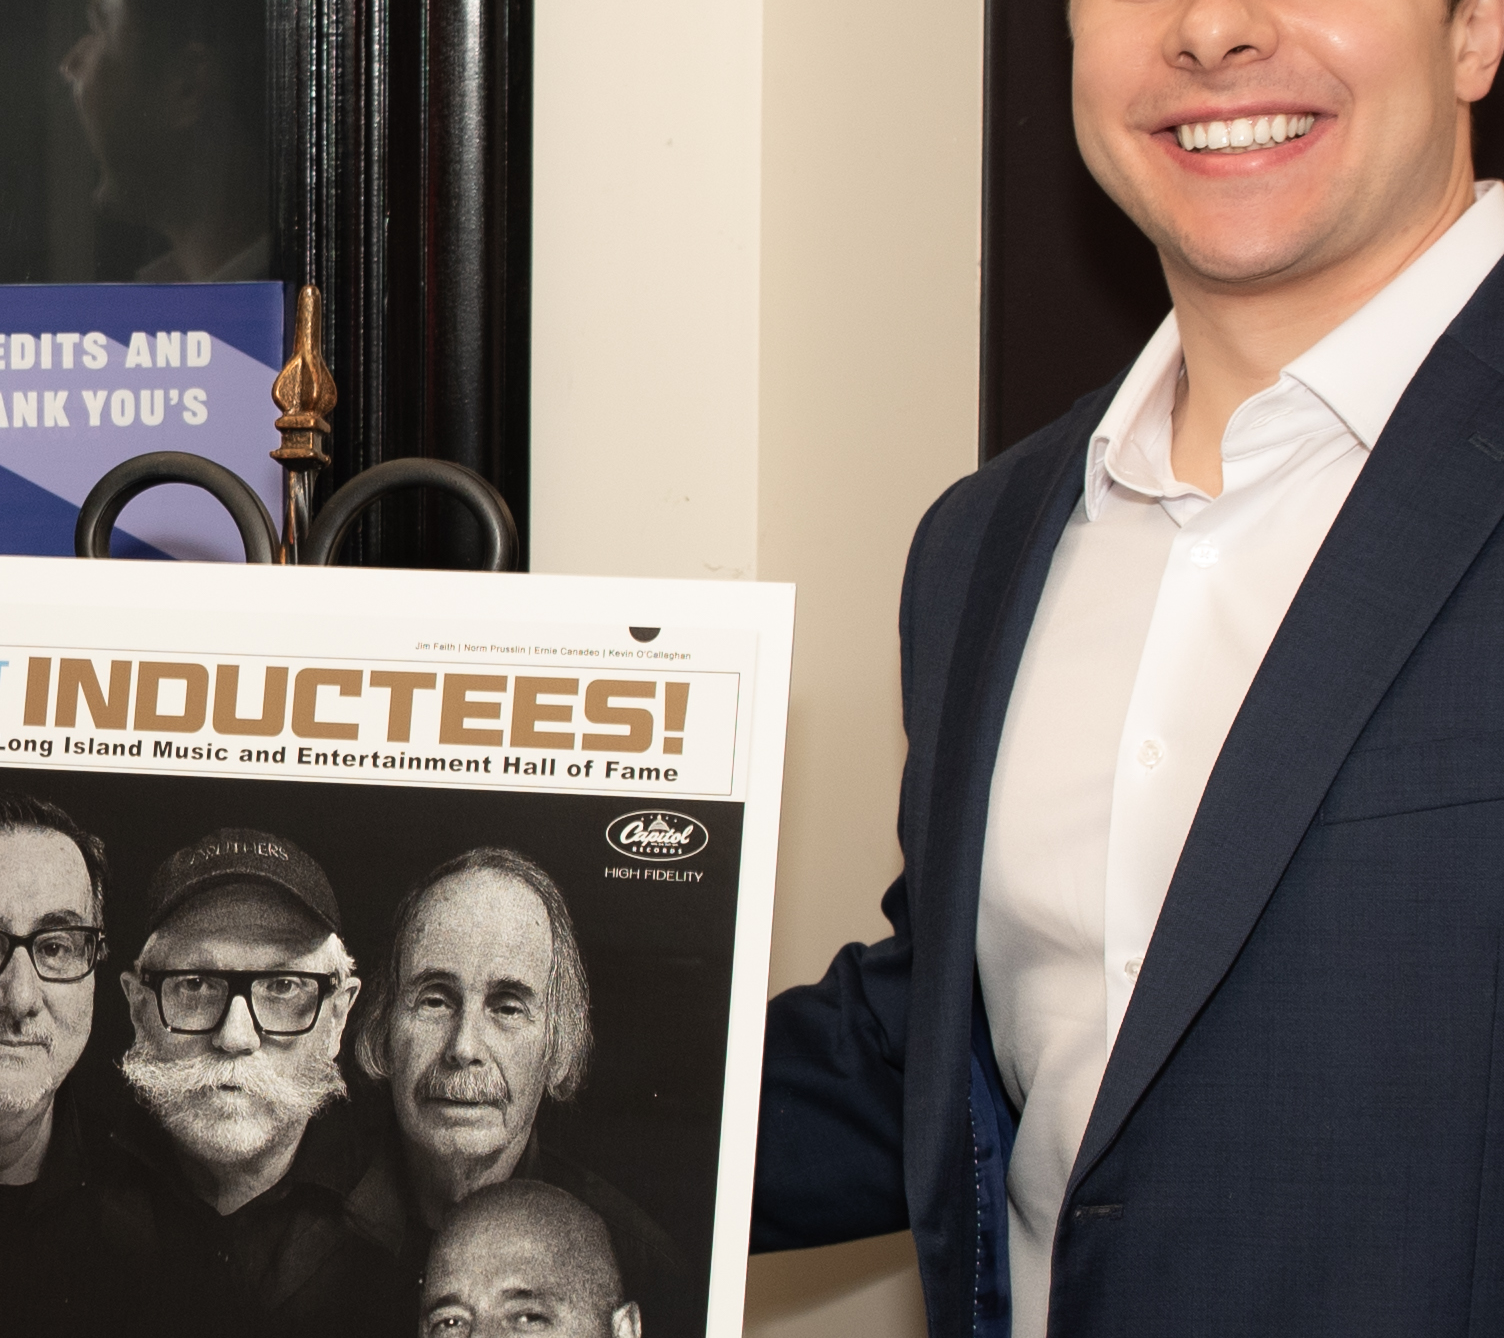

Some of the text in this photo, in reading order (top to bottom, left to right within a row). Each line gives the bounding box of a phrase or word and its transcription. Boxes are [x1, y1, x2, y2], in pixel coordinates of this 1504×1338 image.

[125, 331, 212, 370] AND
[415, 642, 430, 651] Jim
[464, 643, 487, 653] Norm
[534, 646, 557, 656] Ernie
[608, 649, 633, 658] Kevin
[23, 657, 690, 755] INDUCTEES!
[65, 736, 142, 757] Island
[153, 740, 227, 762] Music
[239, 746, 285, 764] and
[298, 747, 491, 774] Entertainment
[504, 756, 555, 776] Hall
[567, 760, 593, 778] of
[606, 761, 678, 782] Fame
[620, 821, 694, 847] Capitol
[632, 846, 683, 855] RECORDS
[604, 867, 703, 882] HIGH FIDELITY
